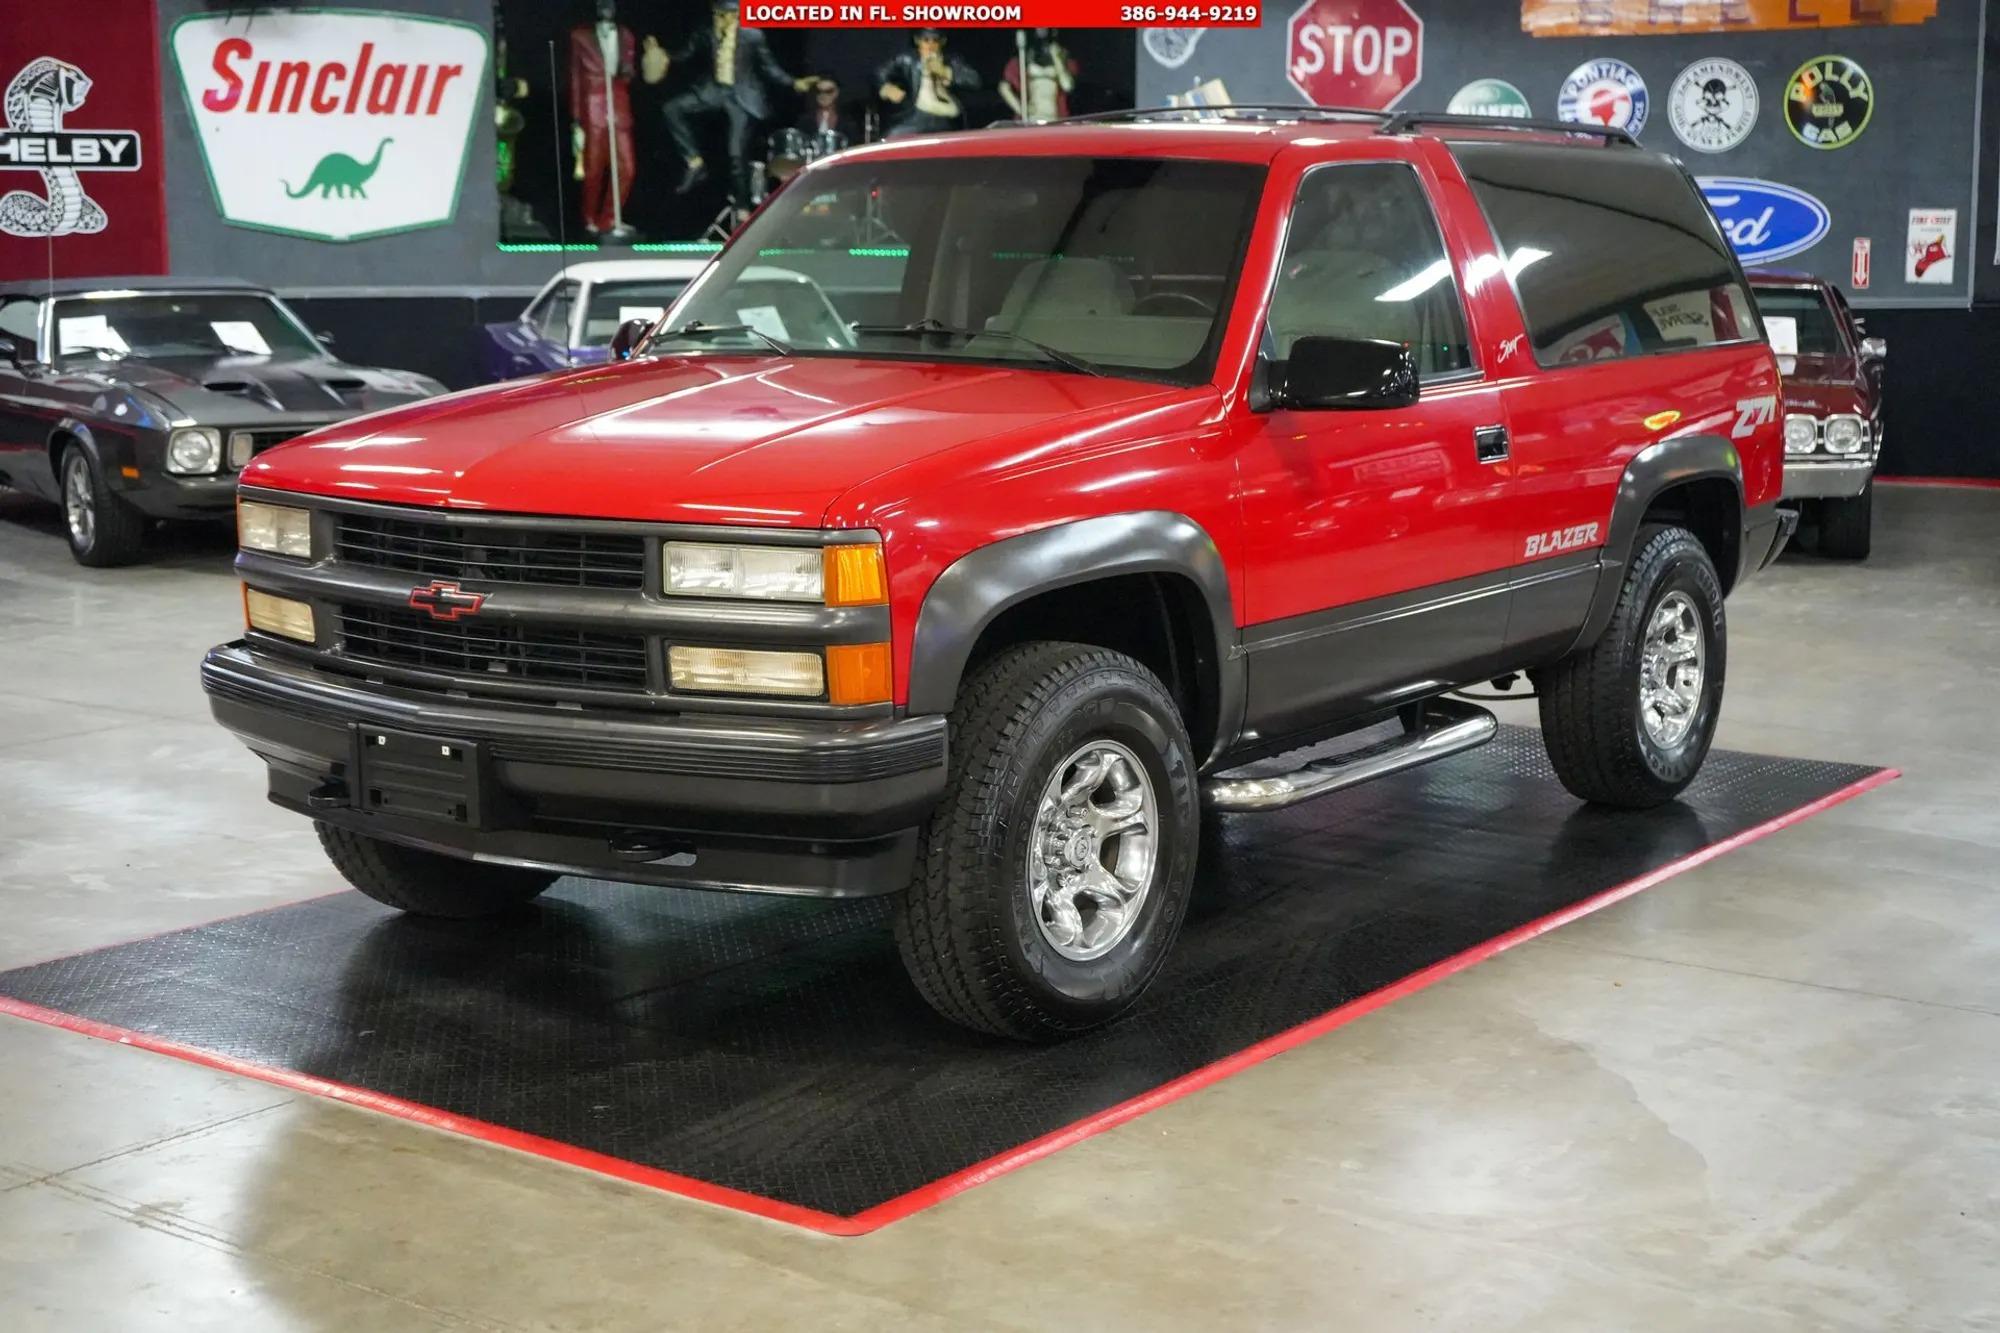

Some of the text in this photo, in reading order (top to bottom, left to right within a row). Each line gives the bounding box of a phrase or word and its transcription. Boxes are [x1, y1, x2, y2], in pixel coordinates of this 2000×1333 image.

[1300, 24, 1413, 76] STOP
[202, 38, 463, 115] Sinclair
[1565, 62, 1640, 97] PONTIAC
[1790, 62, 1869, 101] POLLY
[0, 137, 130, 163] HELBY
[1803, 121, 1853, 143] GAS
[1731, 395, 1777, 439] Z71
[1524, 521, 1599, 558] BLAZER
